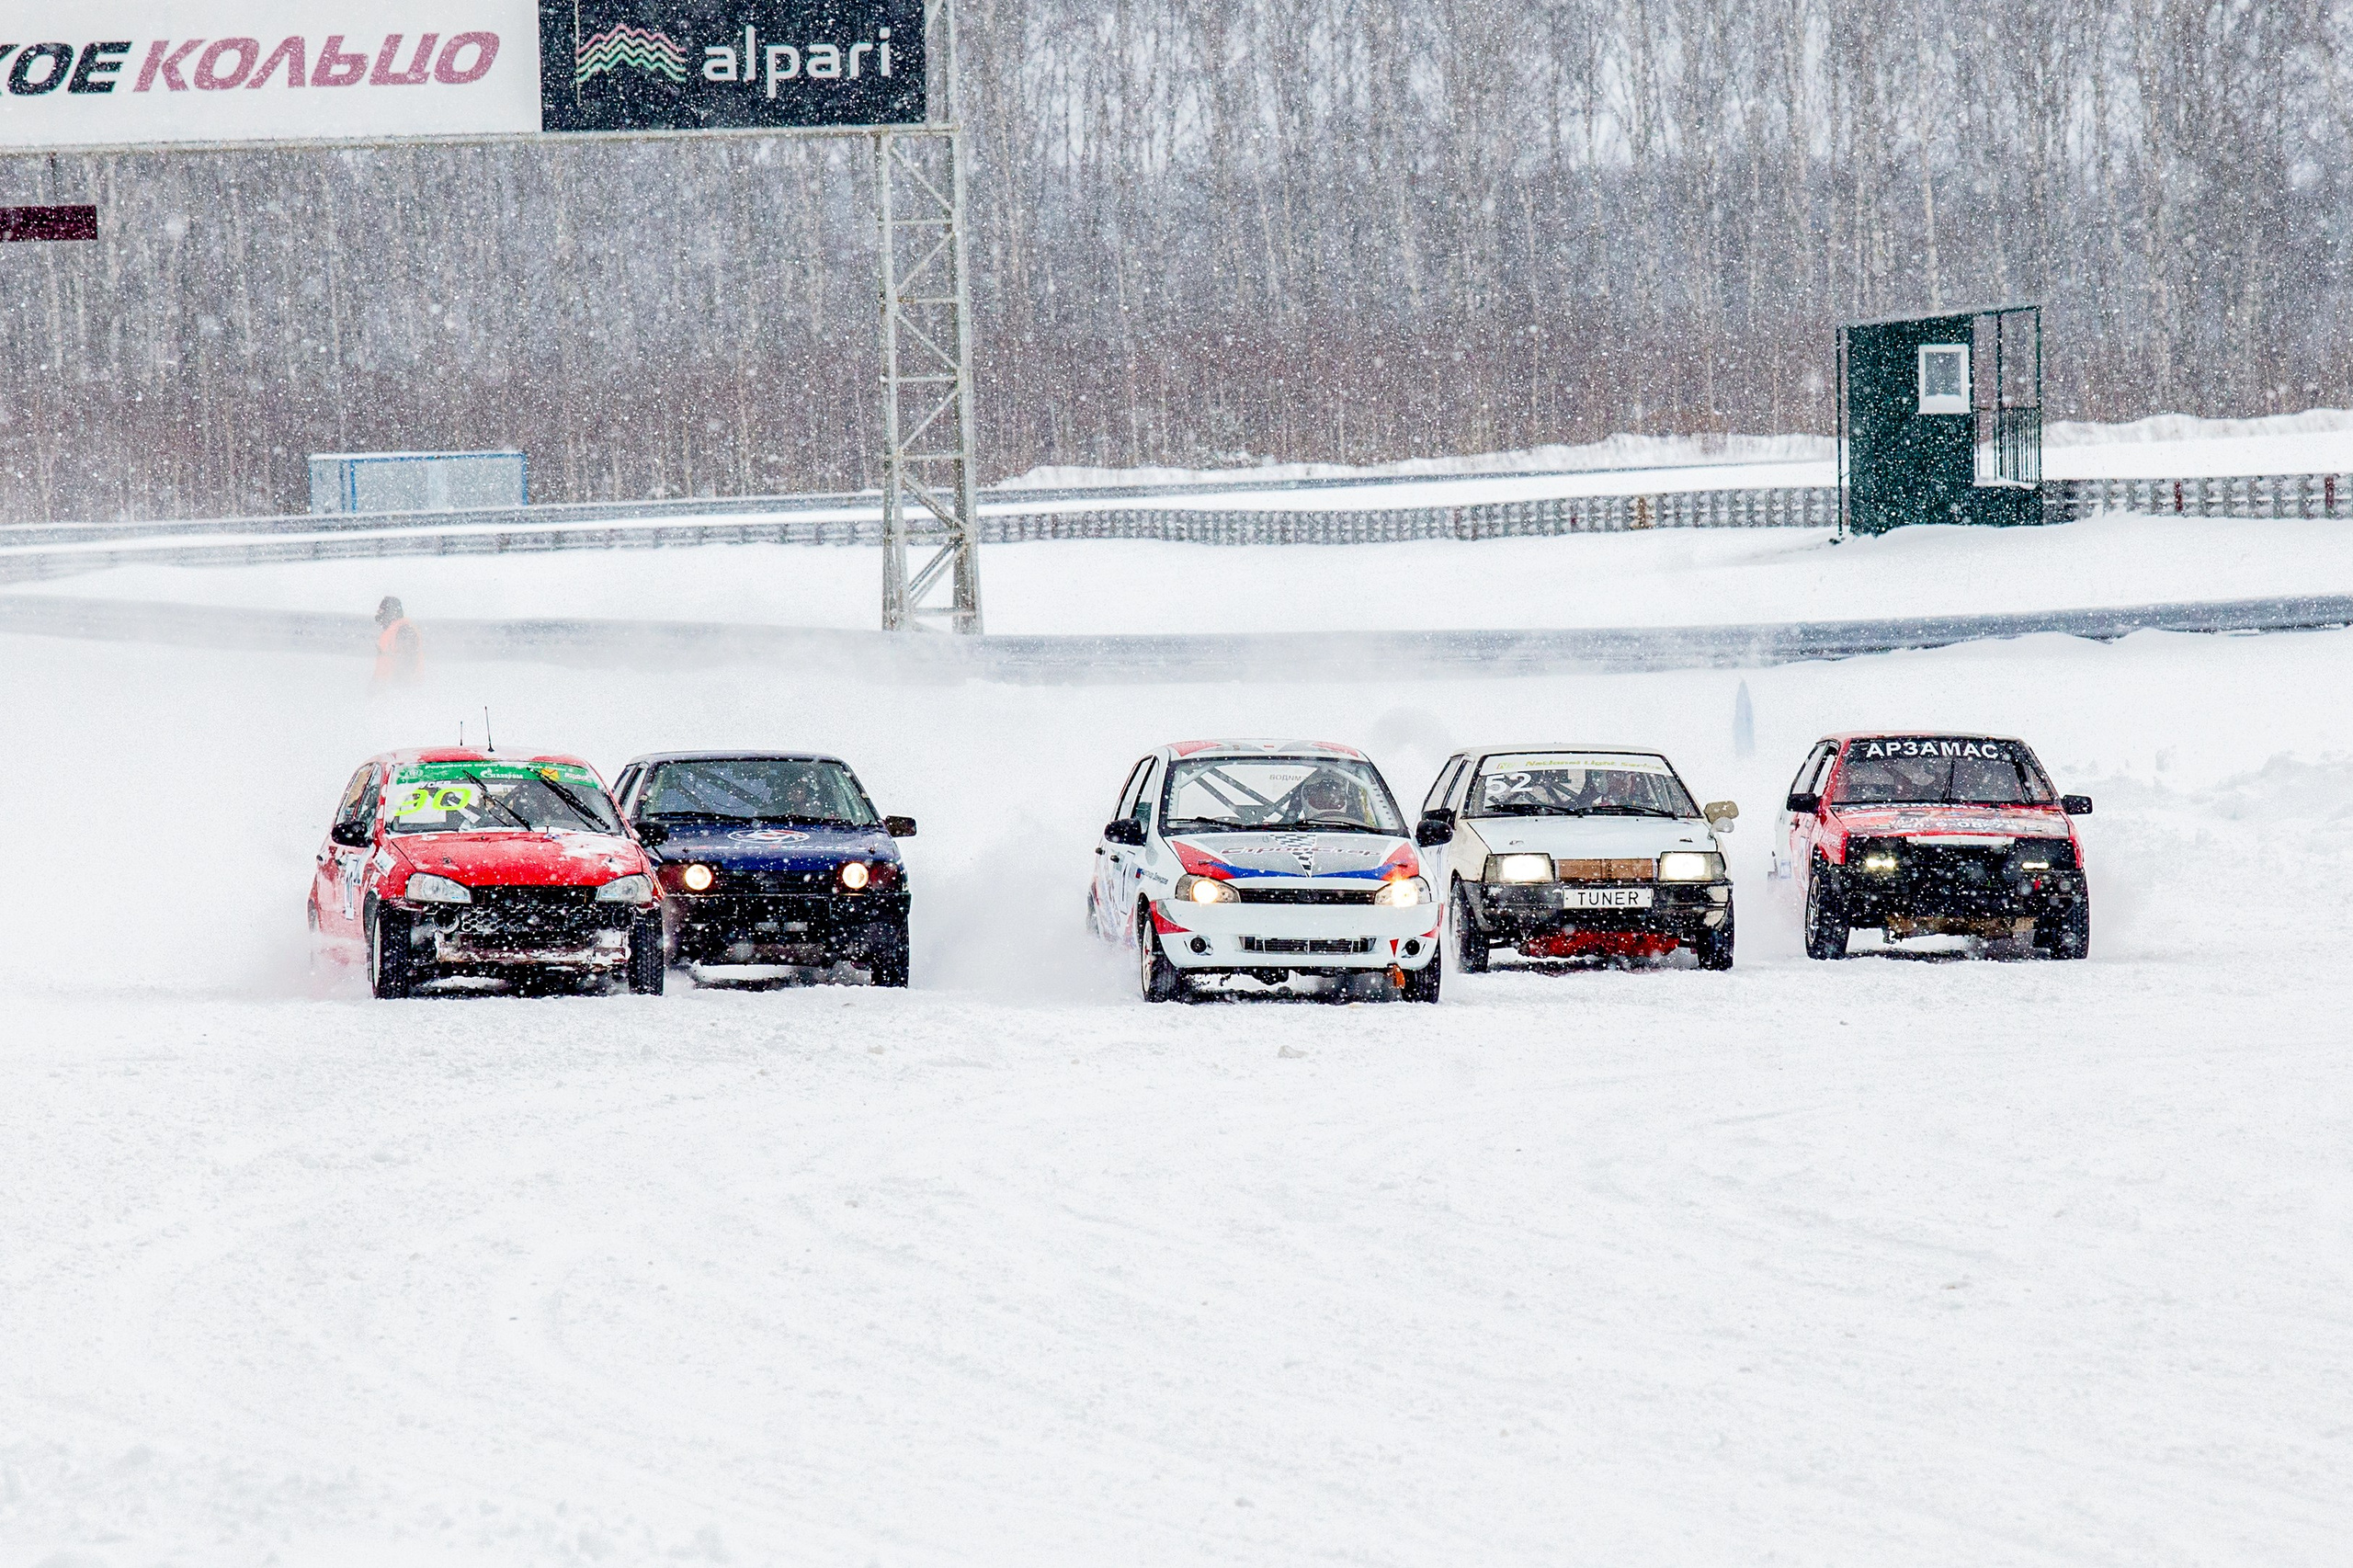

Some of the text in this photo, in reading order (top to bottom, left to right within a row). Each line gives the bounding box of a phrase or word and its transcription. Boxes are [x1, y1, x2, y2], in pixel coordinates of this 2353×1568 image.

[133, 30, 501, 93] КОЛЬЦО
[702, 24, 892, 99] alpari
[1866, 741, 1999, 759] АРЗАМАС
[1484, 772, 1534, 795] 52
[1577, 891, 1639, 906] TUNER
